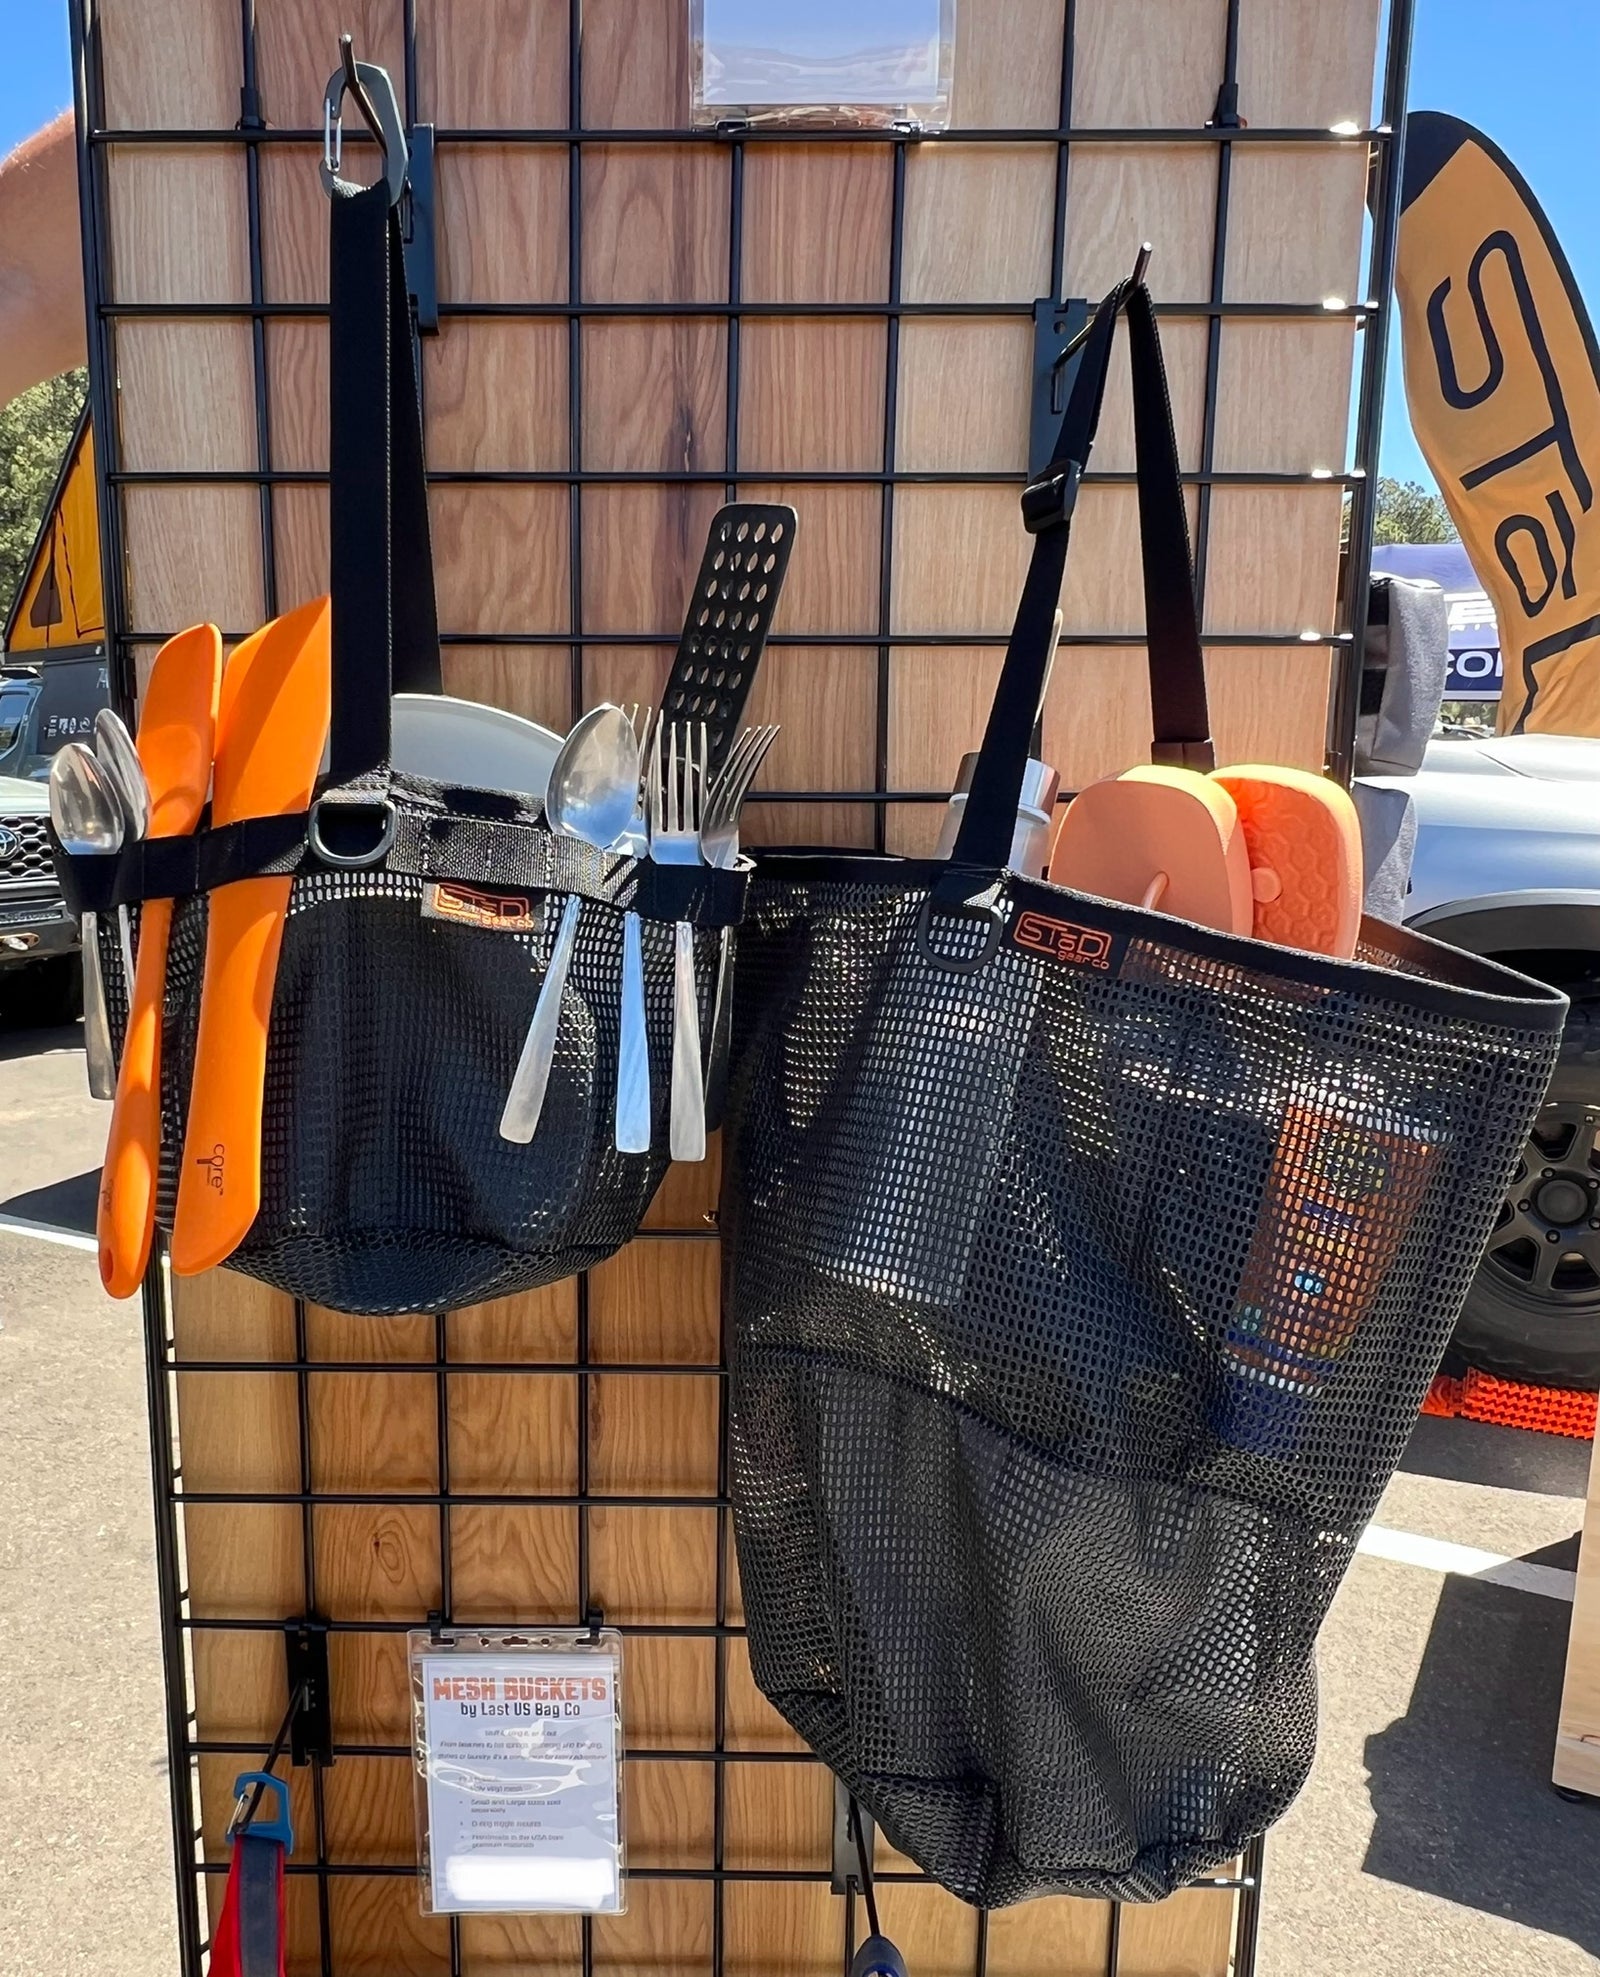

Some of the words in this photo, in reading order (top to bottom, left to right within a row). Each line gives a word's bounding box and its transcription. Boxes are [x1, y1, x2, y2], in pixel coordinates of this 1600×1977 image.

[433, 1677, 496, 1701] MESH
[503, 1677, 606, 1701] BUCKETS
[460, 1702, 477, 1718] by
[481, 1702, 510, 1716] Last
[514, 1703, 531, 1716] US
[535, 1703, 560, 1718] Bag
[564, 1703, 580, 1716] Co
